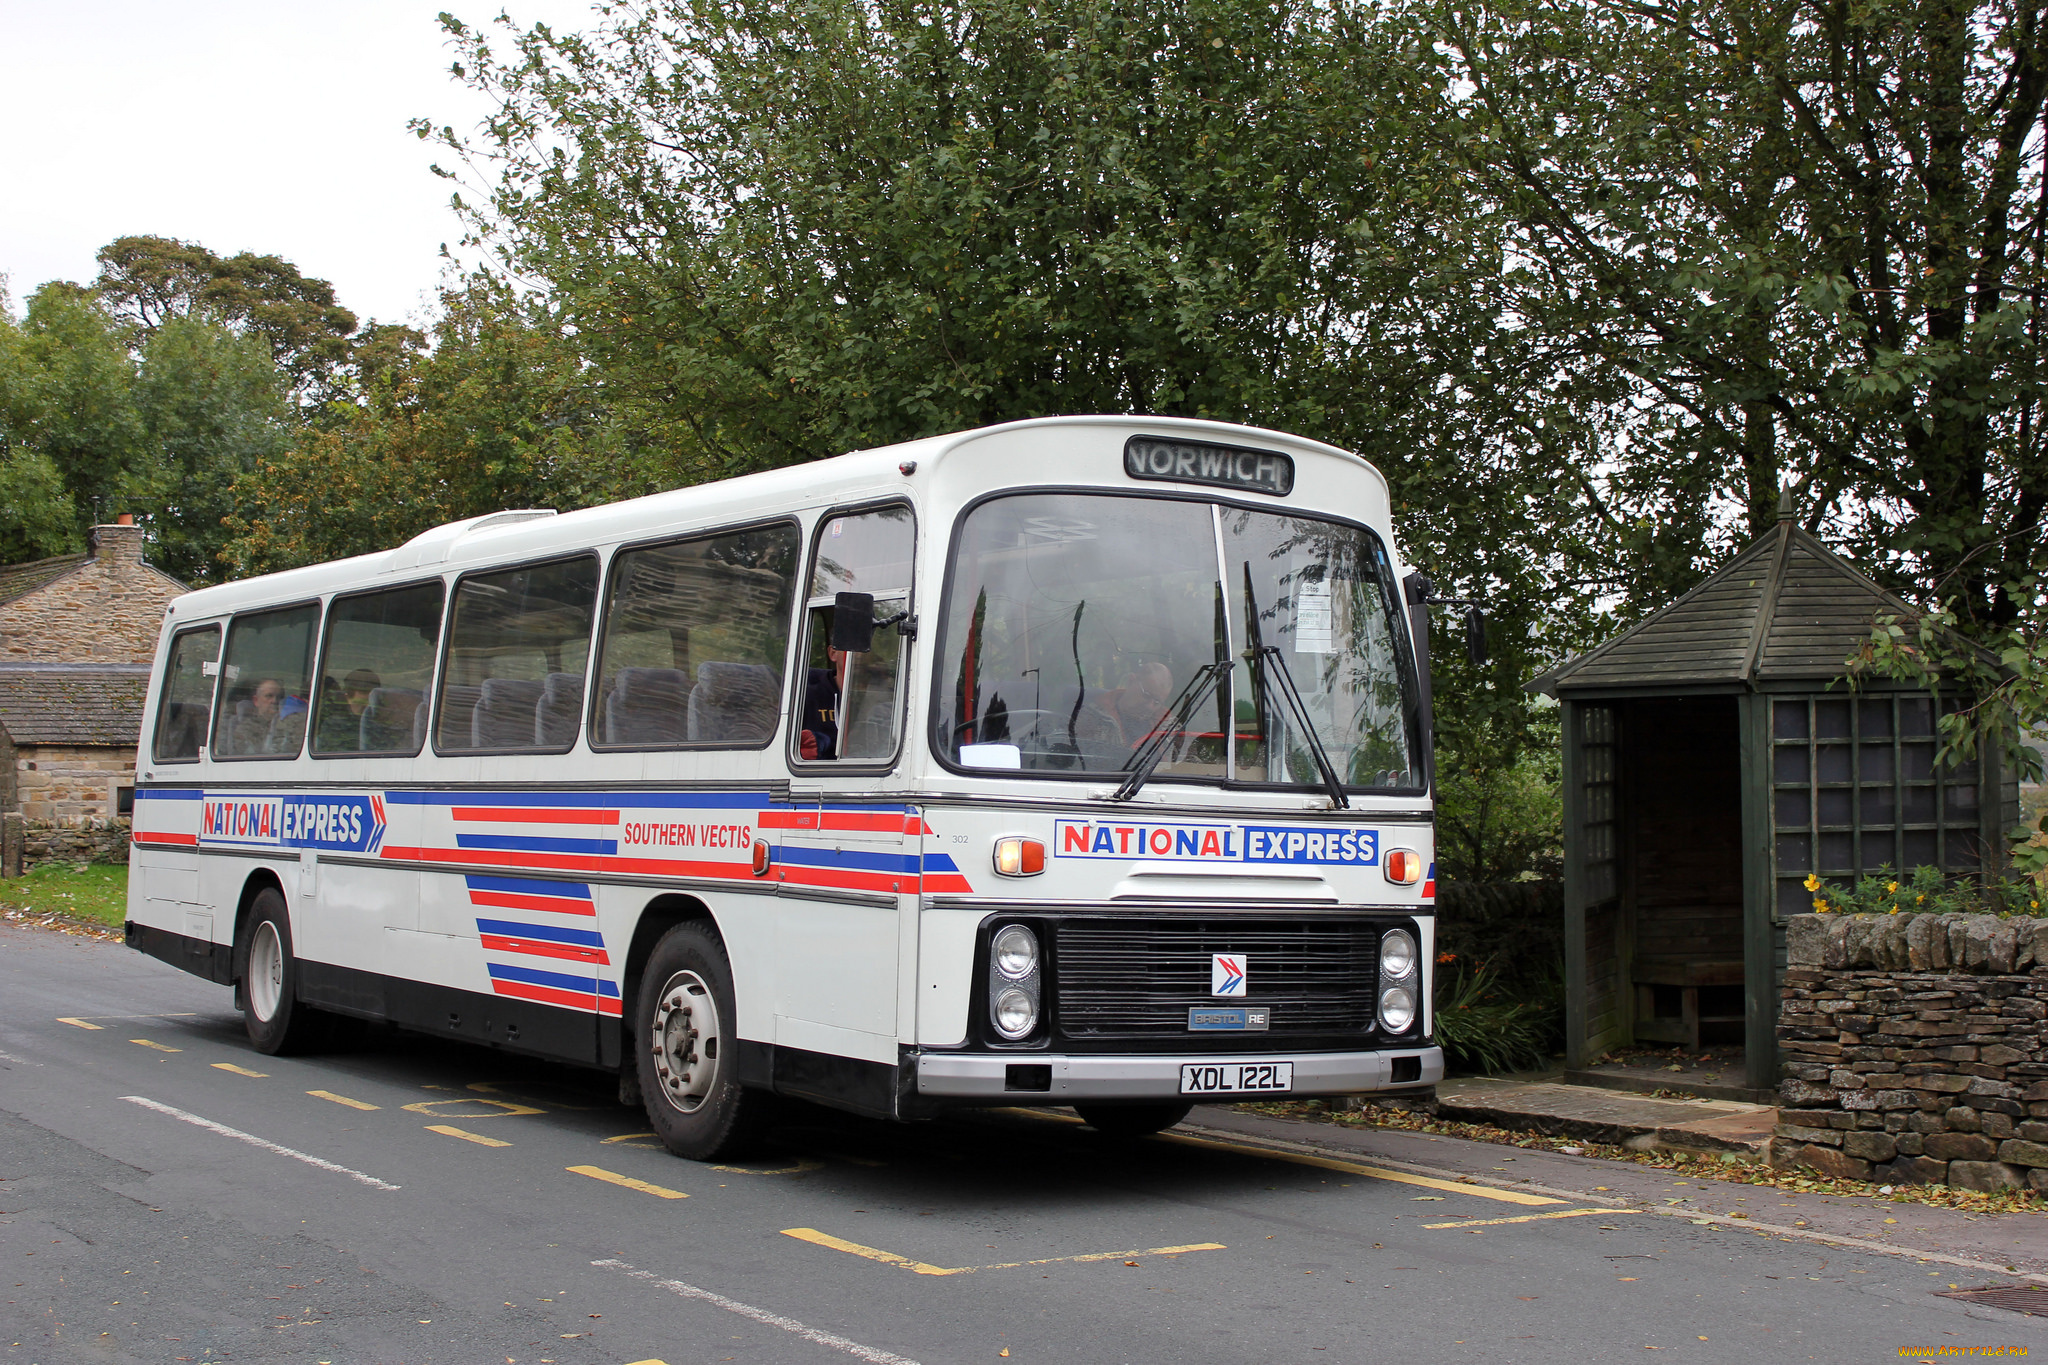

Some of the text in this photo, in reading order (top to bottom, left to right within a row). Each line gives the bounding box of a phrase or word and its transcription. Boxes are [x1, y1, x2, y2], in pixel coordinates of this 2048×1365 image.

[1128, 443, 1277, 483] NORWICH
[203, 801, 363, 844] NATIONAL EXPRESS
[624, 822, 751, 849] SOUTHERN VECTIS
[952, 835, 969, 844] 302
[1064, 825, 1376, 861] NATIONAL EXPRESS
[1194, 1014, 1265, 1025] BRISTOL RE
[1189, 1066, 1285, 1091] XDL 122L
